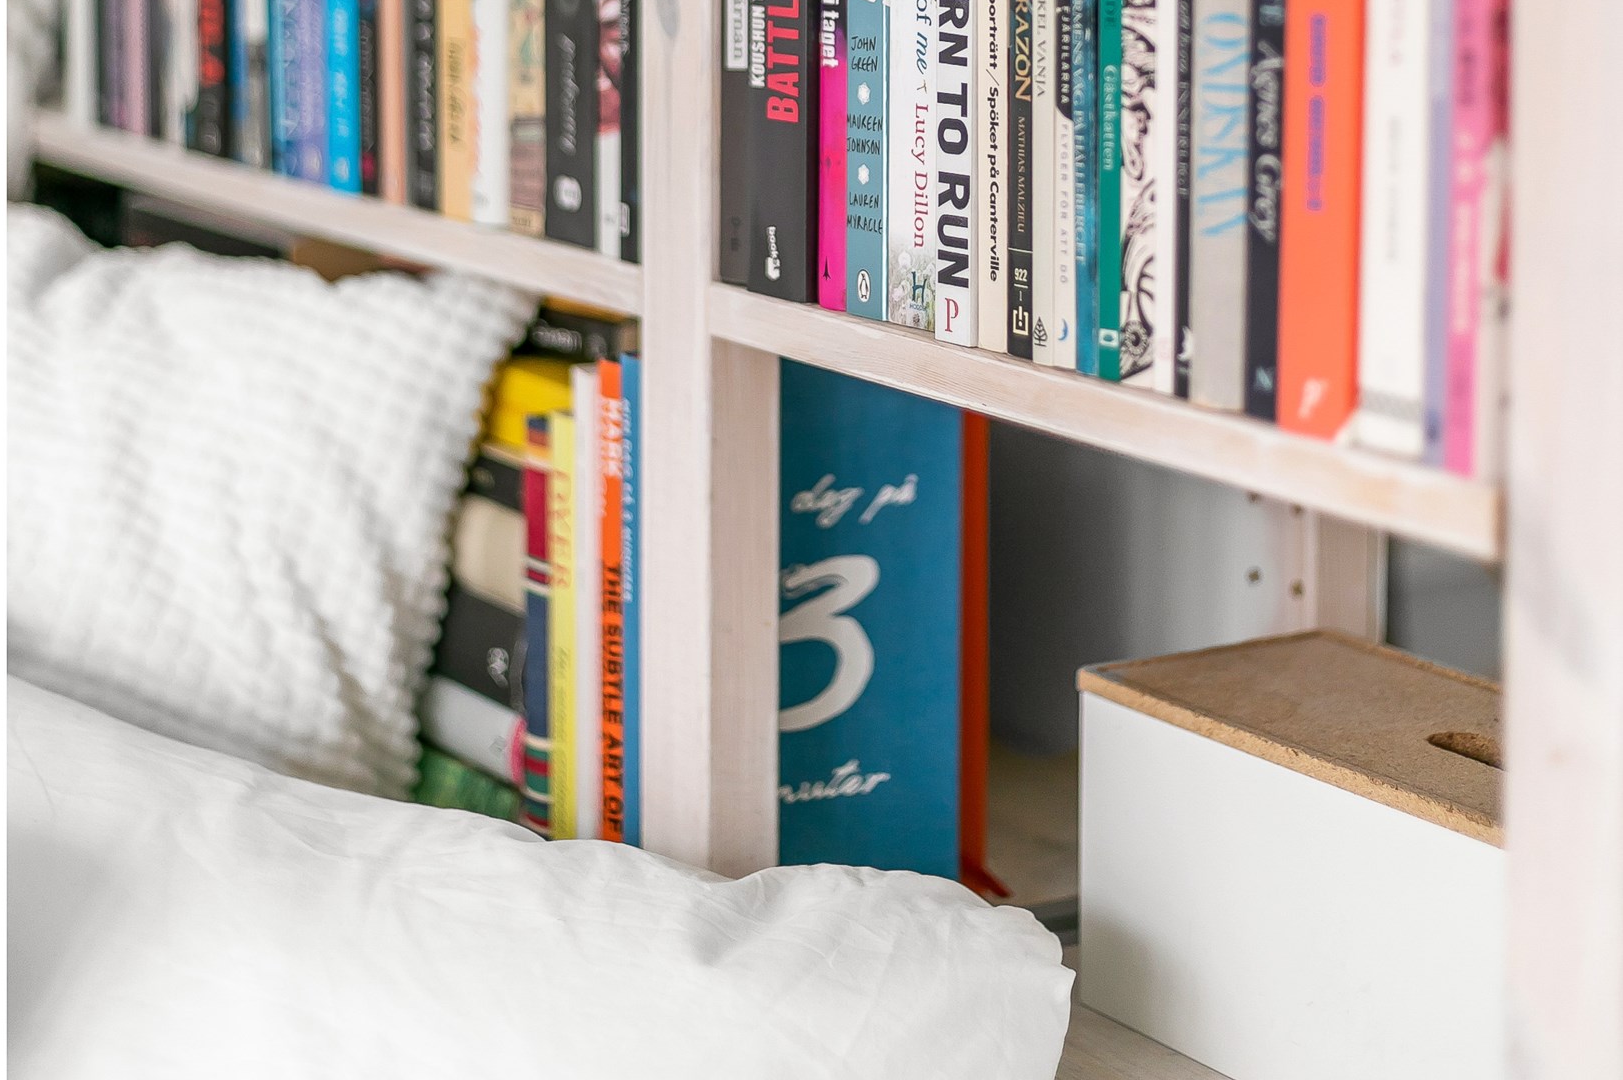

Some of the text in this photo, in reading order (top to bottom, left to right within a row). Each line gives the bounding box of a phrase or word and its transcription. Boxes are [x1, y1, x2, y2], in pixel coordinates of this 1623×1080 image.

[749, 4, 766, 88] KOUSHUN
[820, 9, 840, 68] taget
[850, 35, 877, 52] JOHN
[851, 55, 879, 71] GREEN
[916, 31, 929, 76] me
[1036, 40, 1047, 97] VANJA
[1060, 5, 1071, 104] FJÄRILARNA
[847, 113, 883, 132] MAUREEN
[937, 82, 970, 156] TO
[986, 86, 999, 152] Spöket
[1101, 64, 1119, 170] Gästkatten
[1249, 40, 1285, 150] Agnes
[847, 137, 881, 156] JOHNSON
[911, 102, 929, 249] Lucy Dillon
[987, 154, 999, 178] på
[847, 214, 883, 235] MYRACLE
[849, 193, 880, 209] LAUREN
[937, 170, 971, 289] RUN
[1059, 123, 1070, 284] FLYGER FÖR ATT DÖ
[1249, 153, 1283, 245] Grey
[988, 181, 999, 282] Canterville
[1014, 268, 1028, 282] 922
[944, 297, 959, 333] P
[791, 472, 919, 528] dag på
[779, 554, 881, 733] 3
[602, 561, 626, 837] THE SUBTLE ART OF
